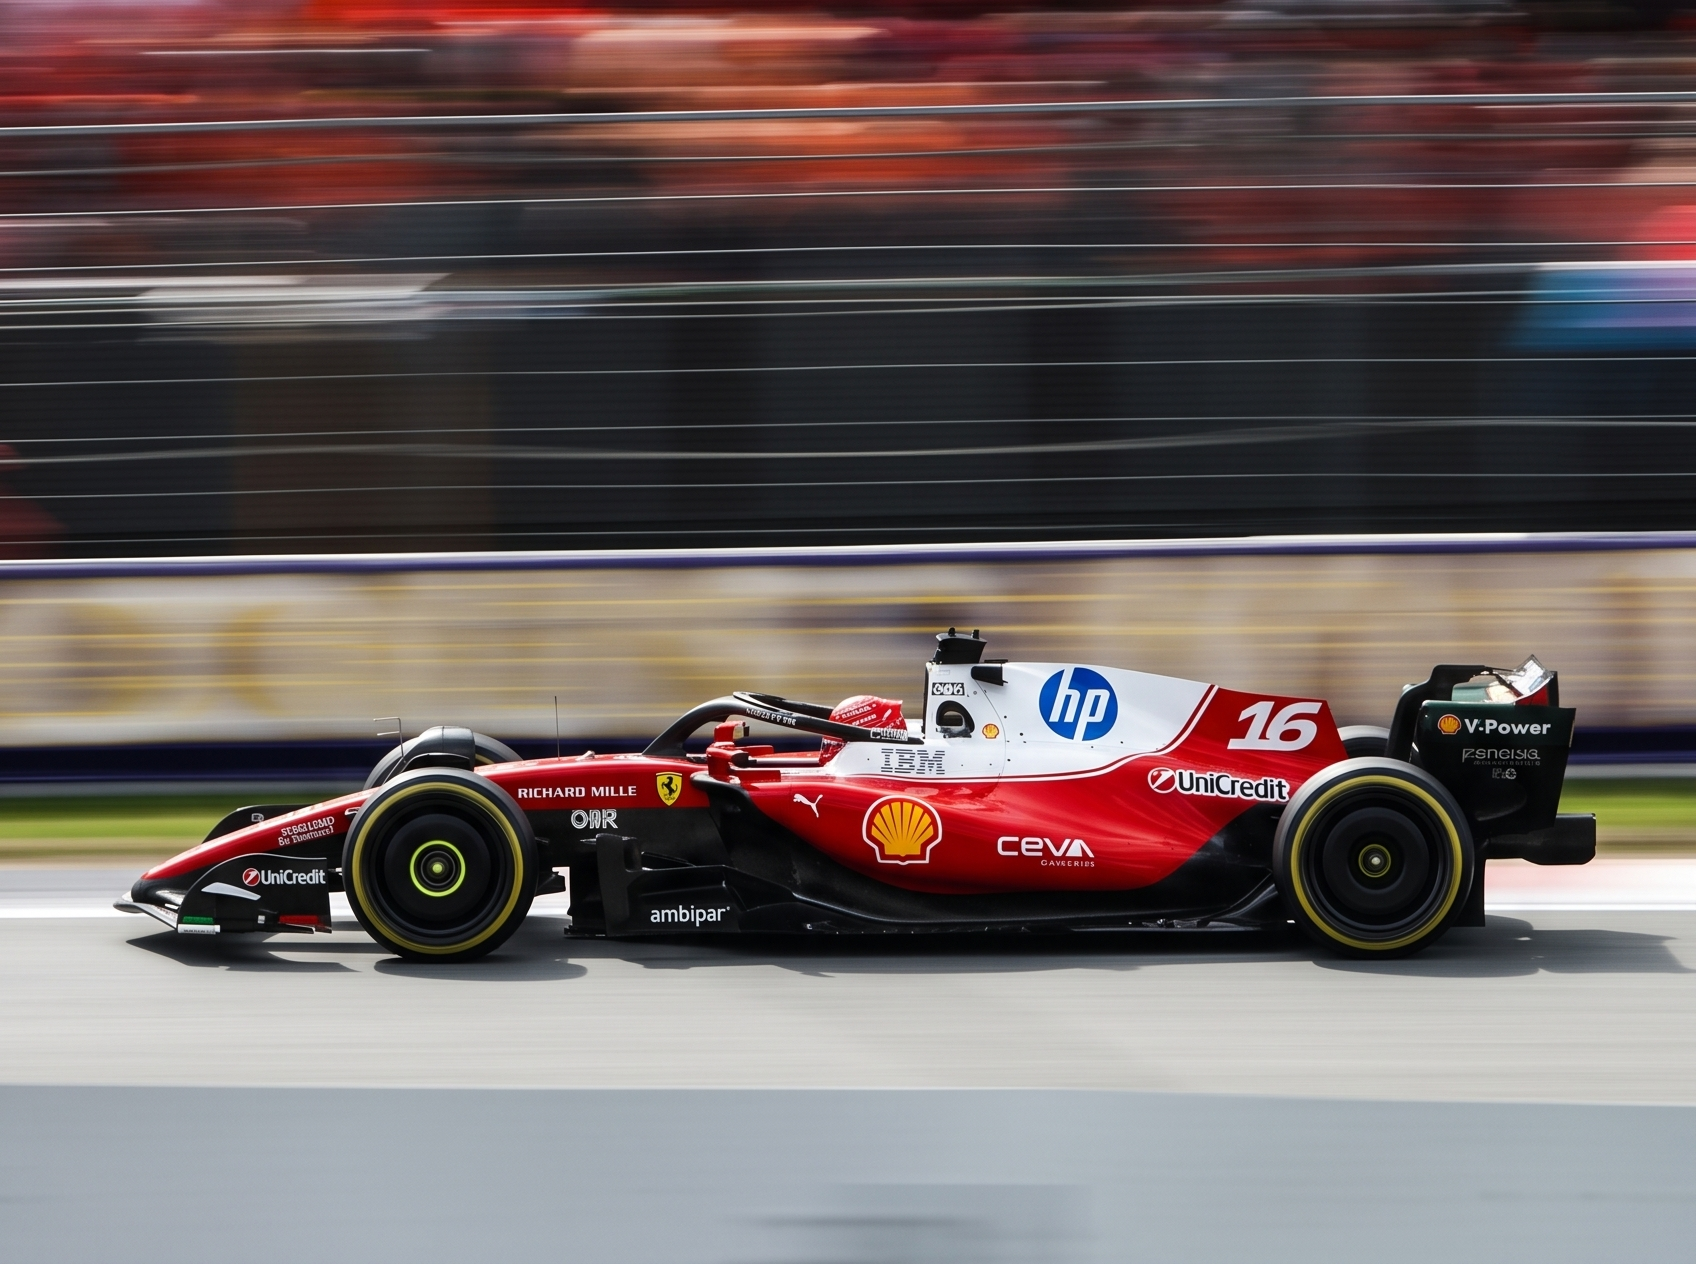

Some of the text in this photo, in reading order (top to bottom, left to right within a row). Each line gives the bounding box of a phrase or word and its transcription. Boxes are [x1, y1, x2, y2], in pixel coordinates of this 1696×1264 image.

[1048, 666, 1111, 742] hp
[1227, 700, 1323, 752] 16
[880, 748, 946, 775] IBM
[517, 785, 637, 799] RICHARD MILLE
[1178, 771, 1287, 800] UniCredit
[261, 869, 326, 885] UniCredit
[650, 905, 726, 927] ambipar
